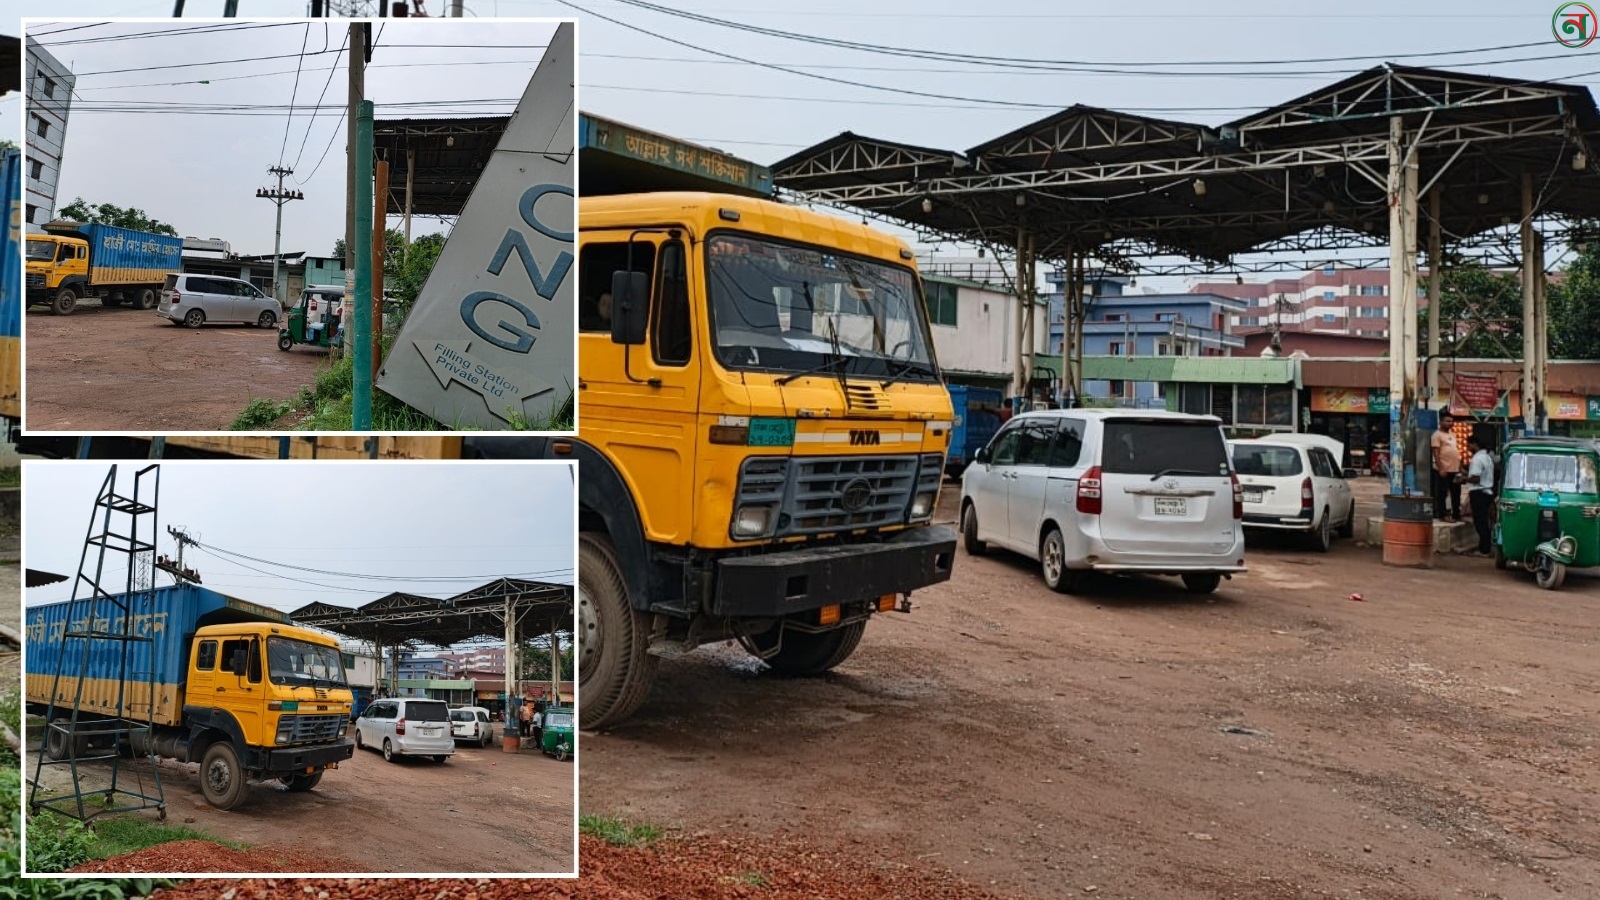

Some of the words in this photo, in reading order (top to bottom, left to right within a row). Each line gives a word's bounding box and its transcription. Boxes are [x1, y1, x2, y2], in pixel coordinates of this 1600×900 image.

[104, 233, 125, 251] হাজী
[434, 342, 471, 369] Filling
[474, 363, 519, 394] Station
[436, 356, 479, 385] Private
[482, 379, 505, 399] Ltd.
[850, 430, 880, 445] TATA
